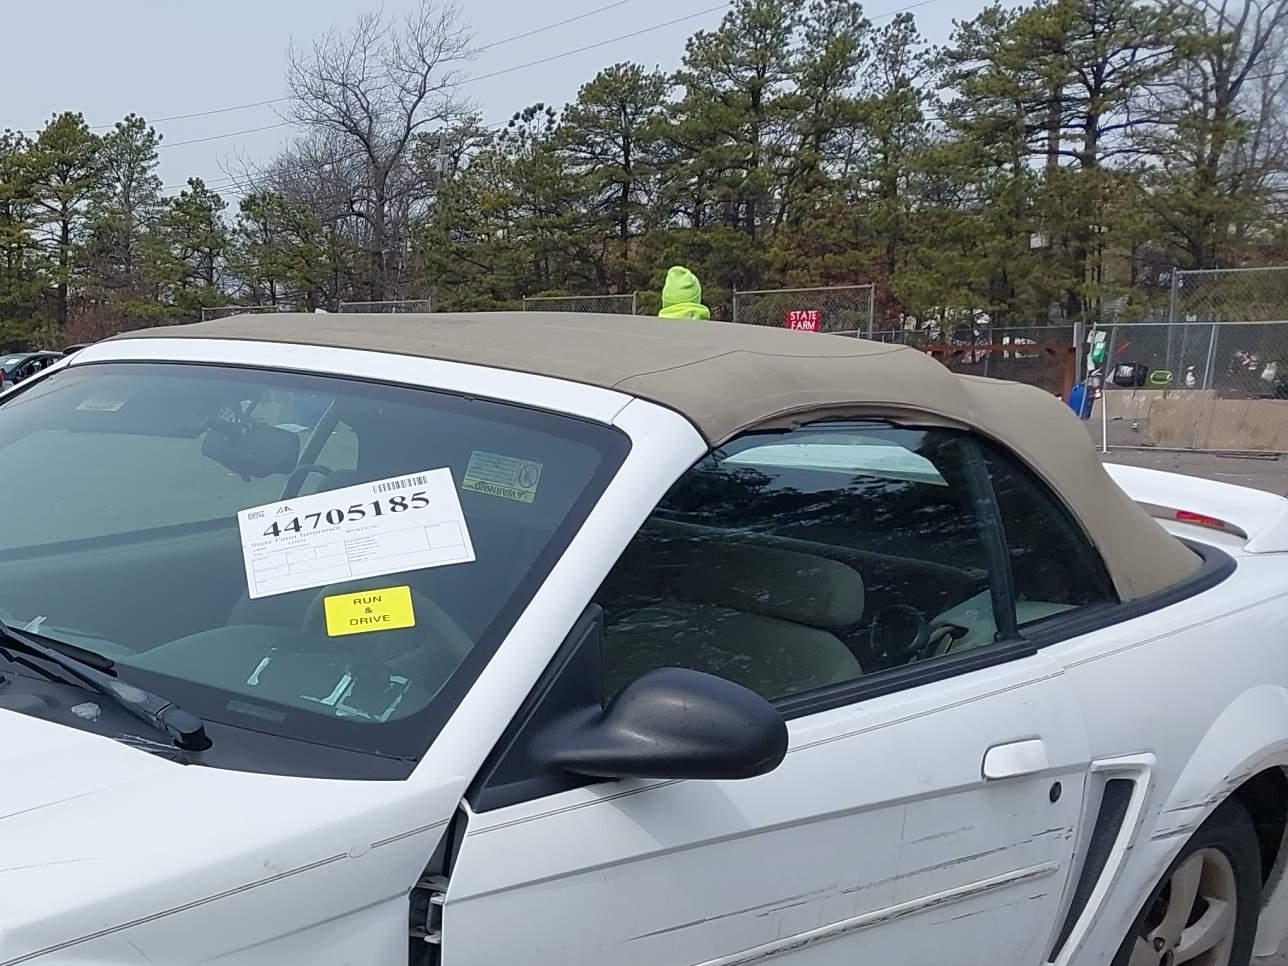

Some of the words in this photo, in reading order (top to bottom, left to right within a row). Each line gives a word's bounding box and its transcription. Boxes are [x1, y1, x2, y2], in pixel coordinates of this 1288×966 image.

[790, 311, 818, 321] STATE
[791, 321, 816, 330] FARM
[473, 481, 516, 498] WARNING
[263, 491, 430, 537] 44705185
[353, 595, 382, 606] RUN
[349, 614, 391, 626] DRIVE
